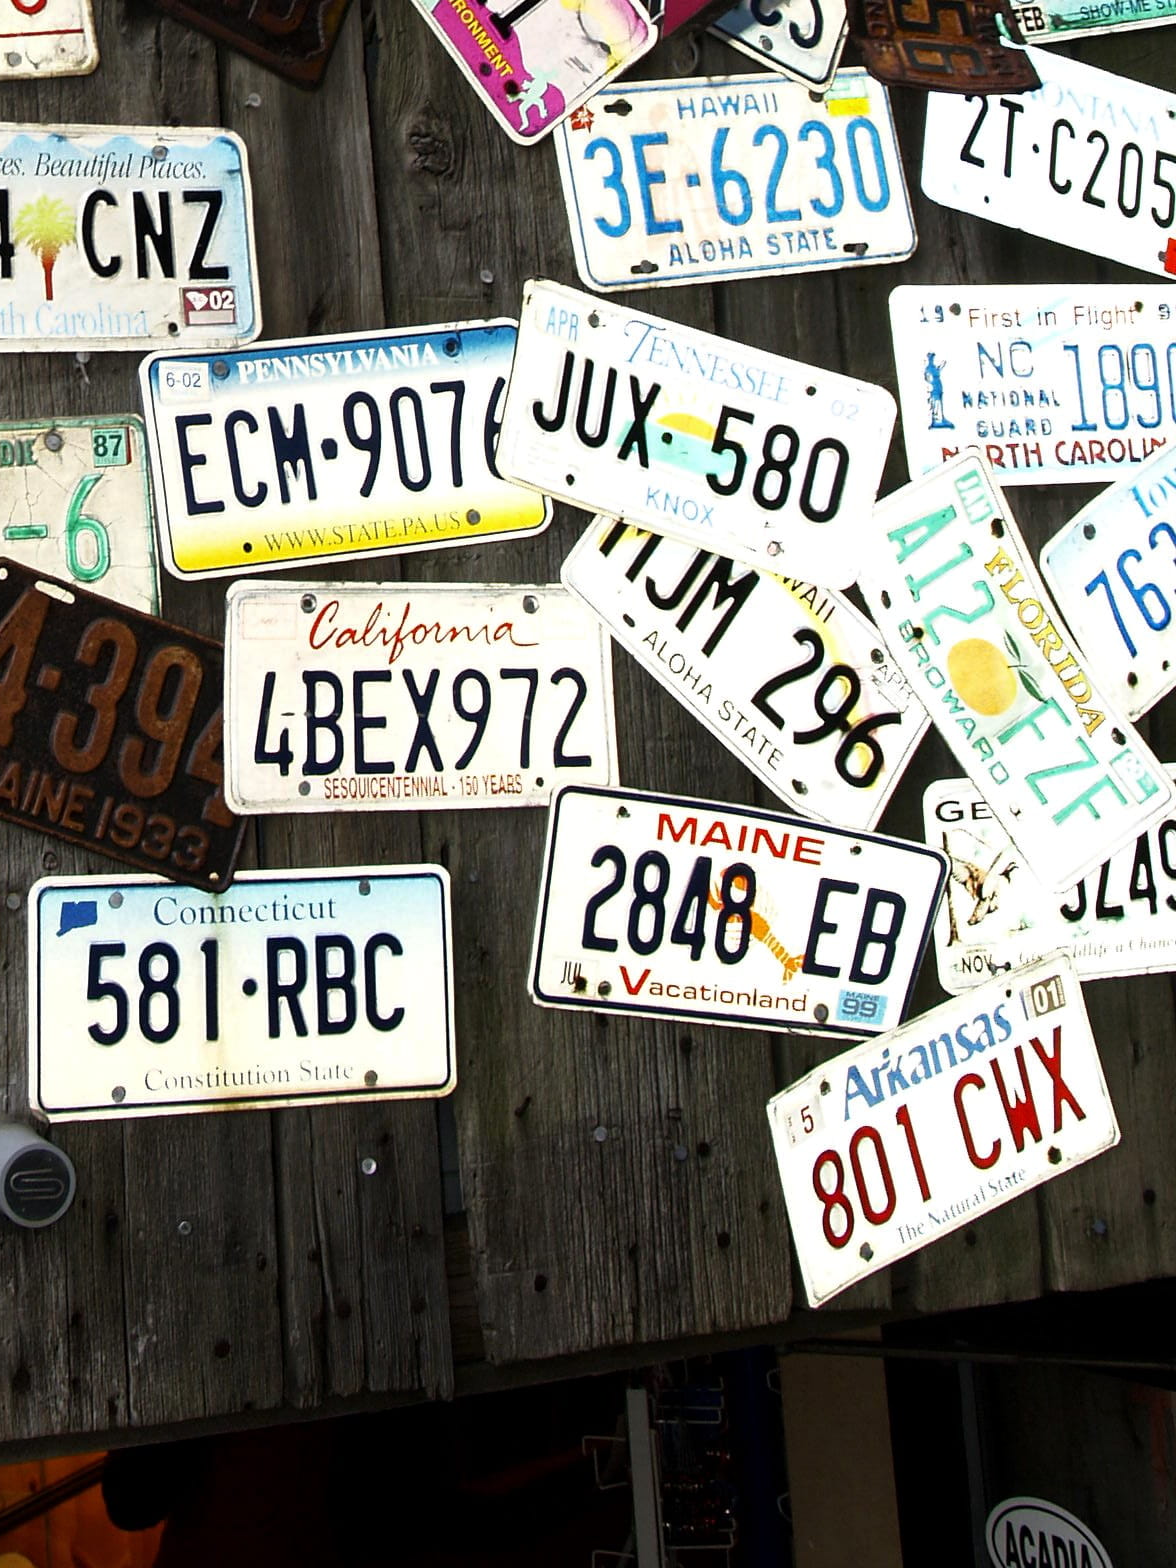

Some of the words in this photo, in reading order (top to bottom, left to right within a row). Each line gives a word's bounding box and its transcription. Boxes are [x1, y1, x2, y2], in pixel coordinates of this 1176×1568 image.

[677, 91, 780, 120] HAWAII
[33, 150, 134, 183] Beautiful
[81, 188, 230, 282] CNZ
[668, 235, 753, 268] ALOHA
[767, 230, 837, 257] STATE
[33, 299, 151, 337] Carolina
[207, 289, 235, 310] 02
[968, 306, 1027, 328] First
[1071, 305, 1136, 333] Flight
[545, 305, 581, 343] APR
[165, 370, 203, 390] 6-02
[235, 341, 439, 387] PENNSYLVANIA
[976, 341, 1035, 380] NC
[961, 388, 1062, 410] NATIONAL
[975, 417, 1053, 439] GUARD
[644, 485, 715, 528] KNOX
[263, 512, 462, 554] WWW.STATE.PA.US
[308, 597, 540, 667] California
[983, 545, 1107, 739] FLORIDA
[640, 628, 714, 705] ALOHA
[716, 698, 787, 772] STATE
[750, 628, 902, 790] 296
[896, 618, 1009, 787] BROWARD
[253, 667, 593, 777] 4BEX972
[322, 774, 450, 800] SESQUICENTENNIAL
[655, 812, 827, 867] MAINE
[152, 894, 338, 927] Connecticut
[580, 843, 758, 967] 2848
[802, 877, 907, 986] EB
[618, 964, 809, 1014] Vacationland
[143, 1064, 292, 1093] Constitution
[297, 1060, 355, 1083] State
[842, 999, 1014, 1123] Arkansas
[810, 1102, 933, 1250] 801
[952, 1024, 1088, 1171] CWX
